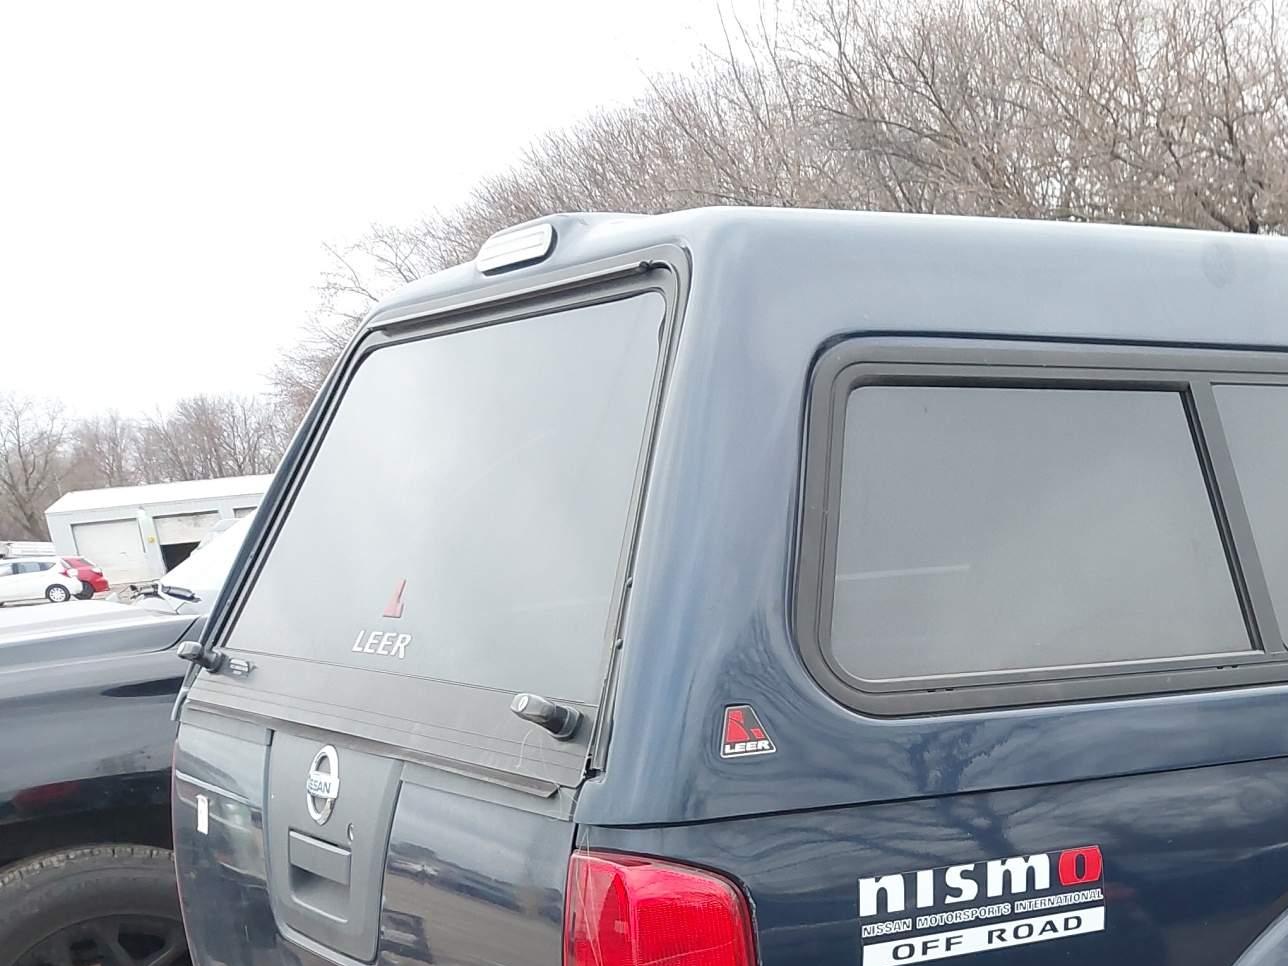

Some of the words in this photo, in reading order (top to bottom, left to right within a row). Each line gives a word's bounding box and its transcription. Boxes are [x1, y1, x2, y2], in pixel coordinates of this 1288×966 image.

[351, 629, 412, 659] LEER
[724, 740, 770, 754] LEER
[857, 844, 1104, 918] nismo
[862, 917, 913, 938] NISSAN
[916, 903, 1011, 929] MOTORSPORTS
[1014, 888, 1104, 913] INTERNATIONAL
[892, 934, 964, 961] OFF
[987, 915, 1083, 944] ROAD
